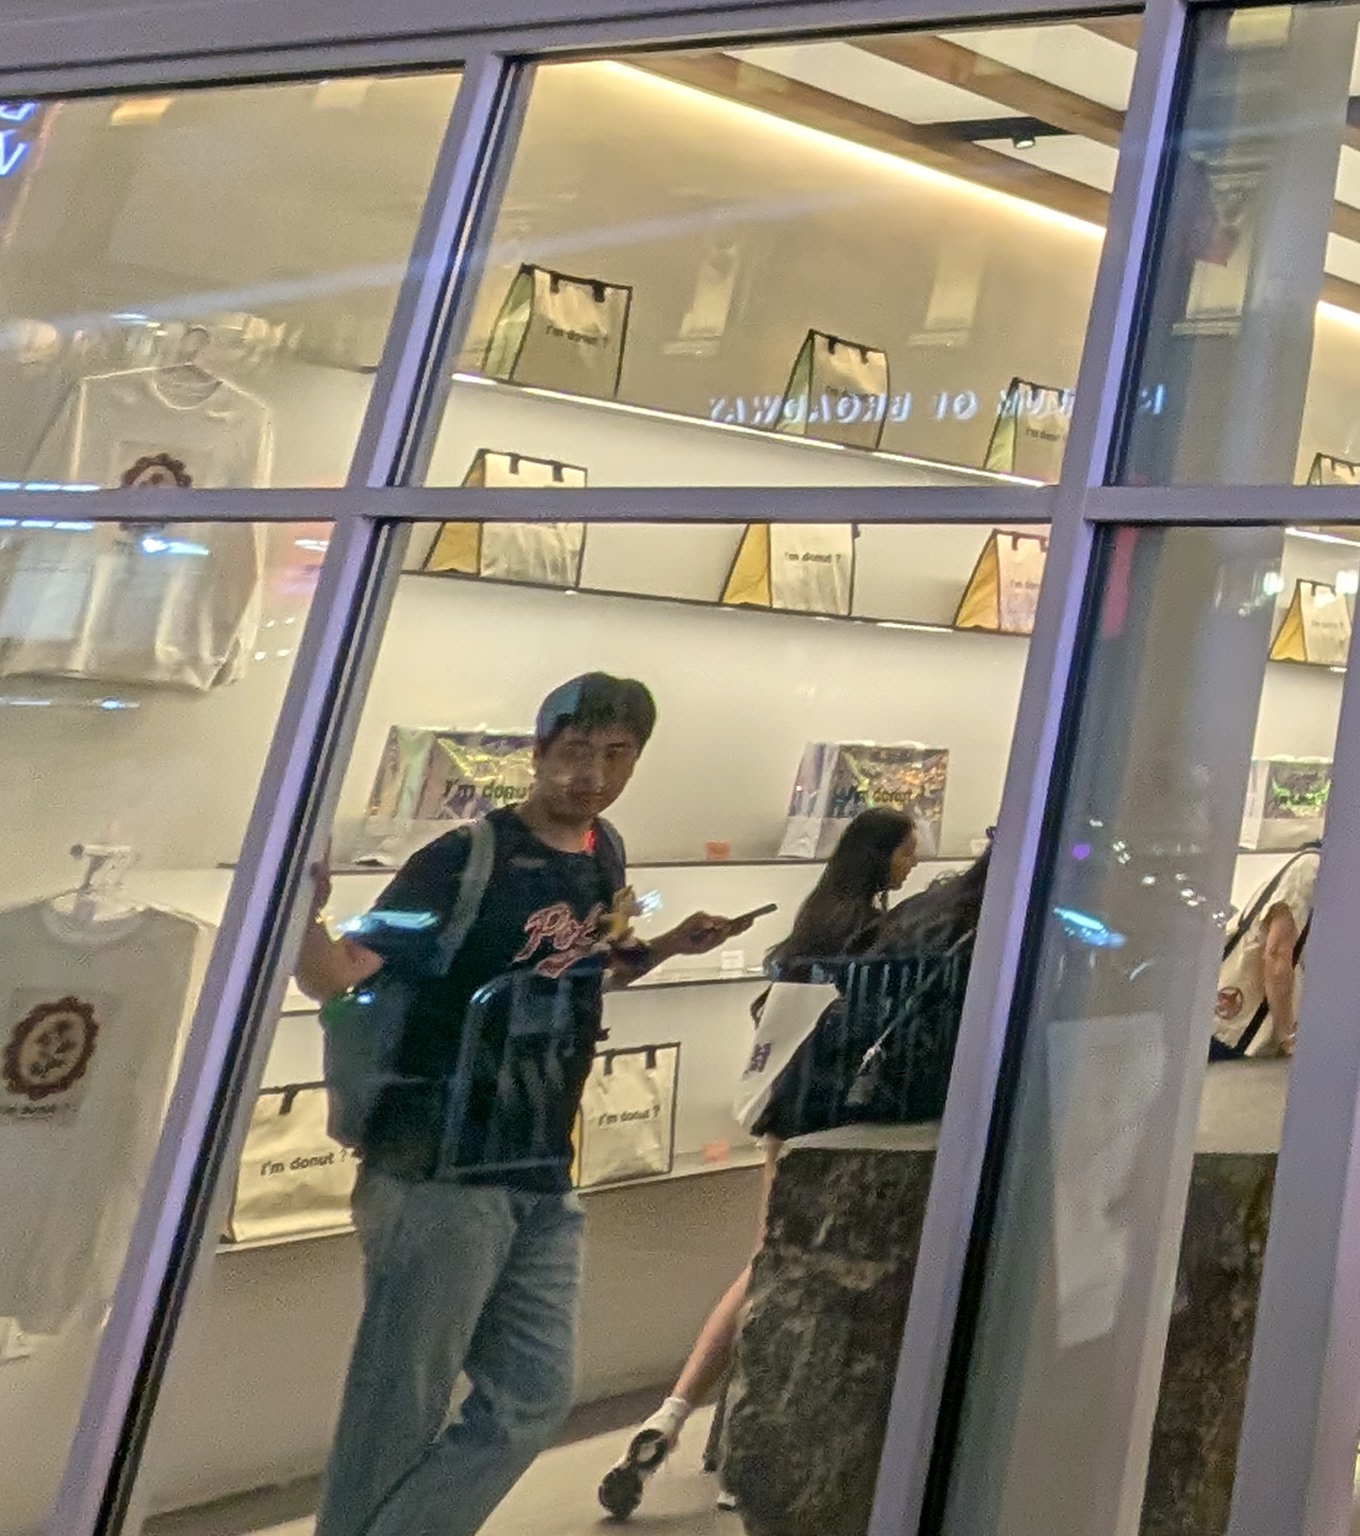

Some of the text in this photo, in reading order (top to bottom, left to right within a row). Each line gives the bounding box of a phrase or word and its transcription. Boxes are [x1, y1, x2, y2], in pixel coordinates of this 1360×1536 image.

[482, 778, 529, 800] donu
[260, 1161, 285, 1176] I'm
[289, 1152, 335, 1171] donut
